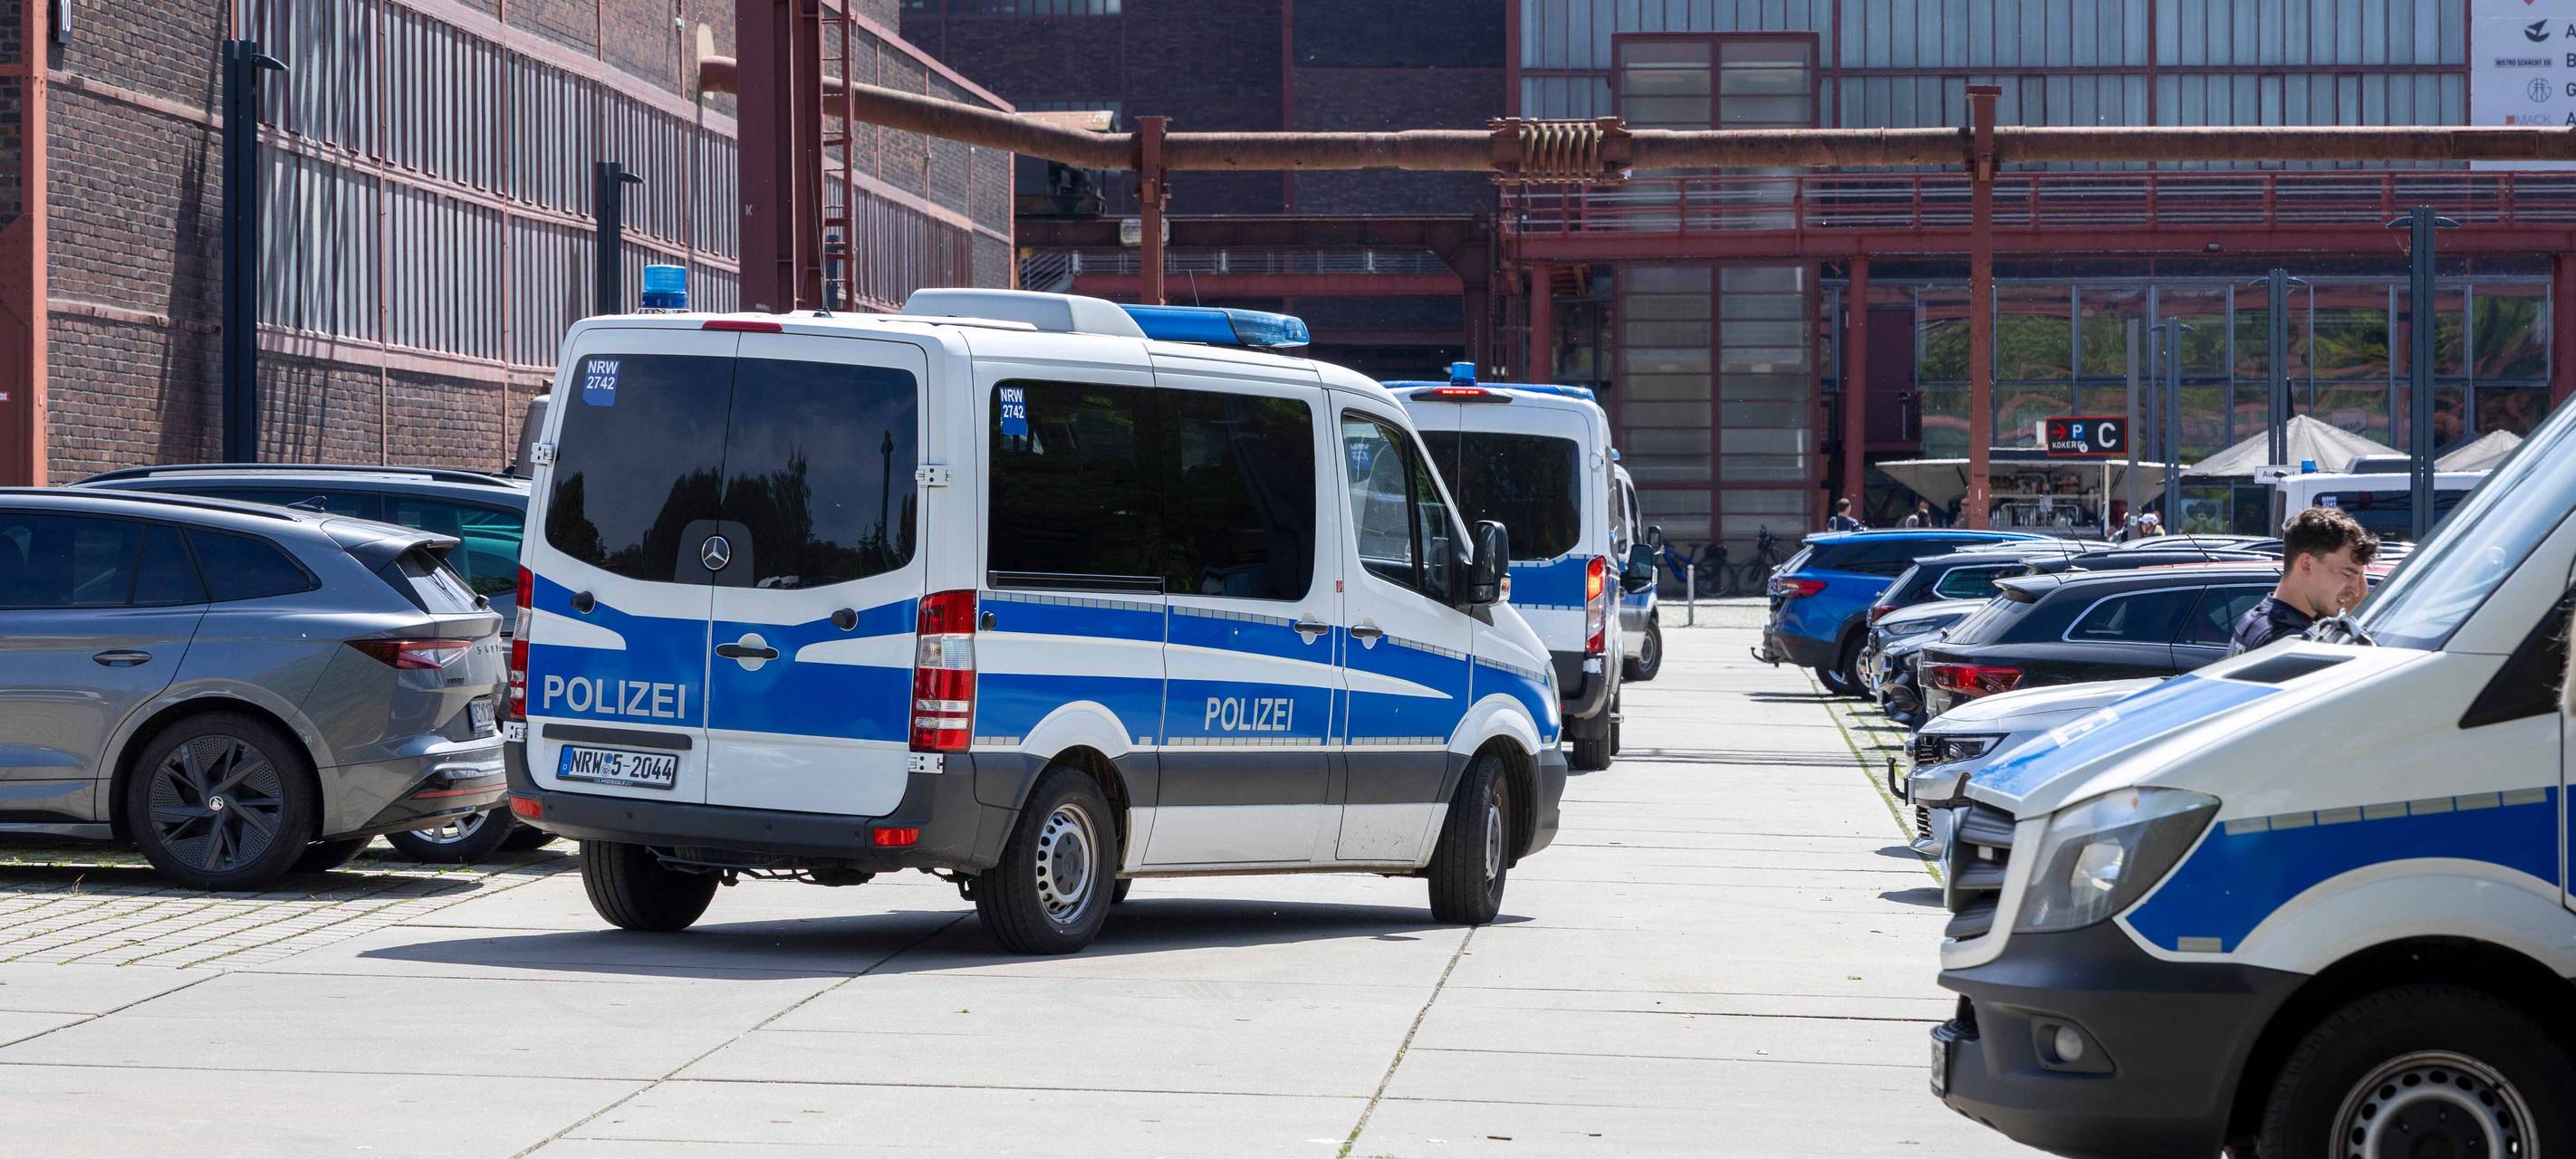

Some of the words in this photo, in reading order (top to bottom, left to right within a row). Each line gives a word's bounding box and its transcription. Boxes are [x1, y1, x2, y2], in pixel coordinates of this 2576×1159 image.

[62, 0, 72, 32] 10
[2515, 115, 2552, 125] MACK
[745, 204, 754, 216] K
[587, 360, 619, 375] NRW
[586, 376, 616, 390] 2742
[1000, 388, 1023, 403] NRW
[1003, 404, 1024, 419] 2742
[2071, 424, 2083, 438] P
[2098, 422, 2117, 448] C
[543, 675, 686, 719] POLIZEI
[1204, 696, 1294, 732] POLIZEI
[570, 750, 604, 774] NRW
[610, 753, 672, 781] 5-2044
